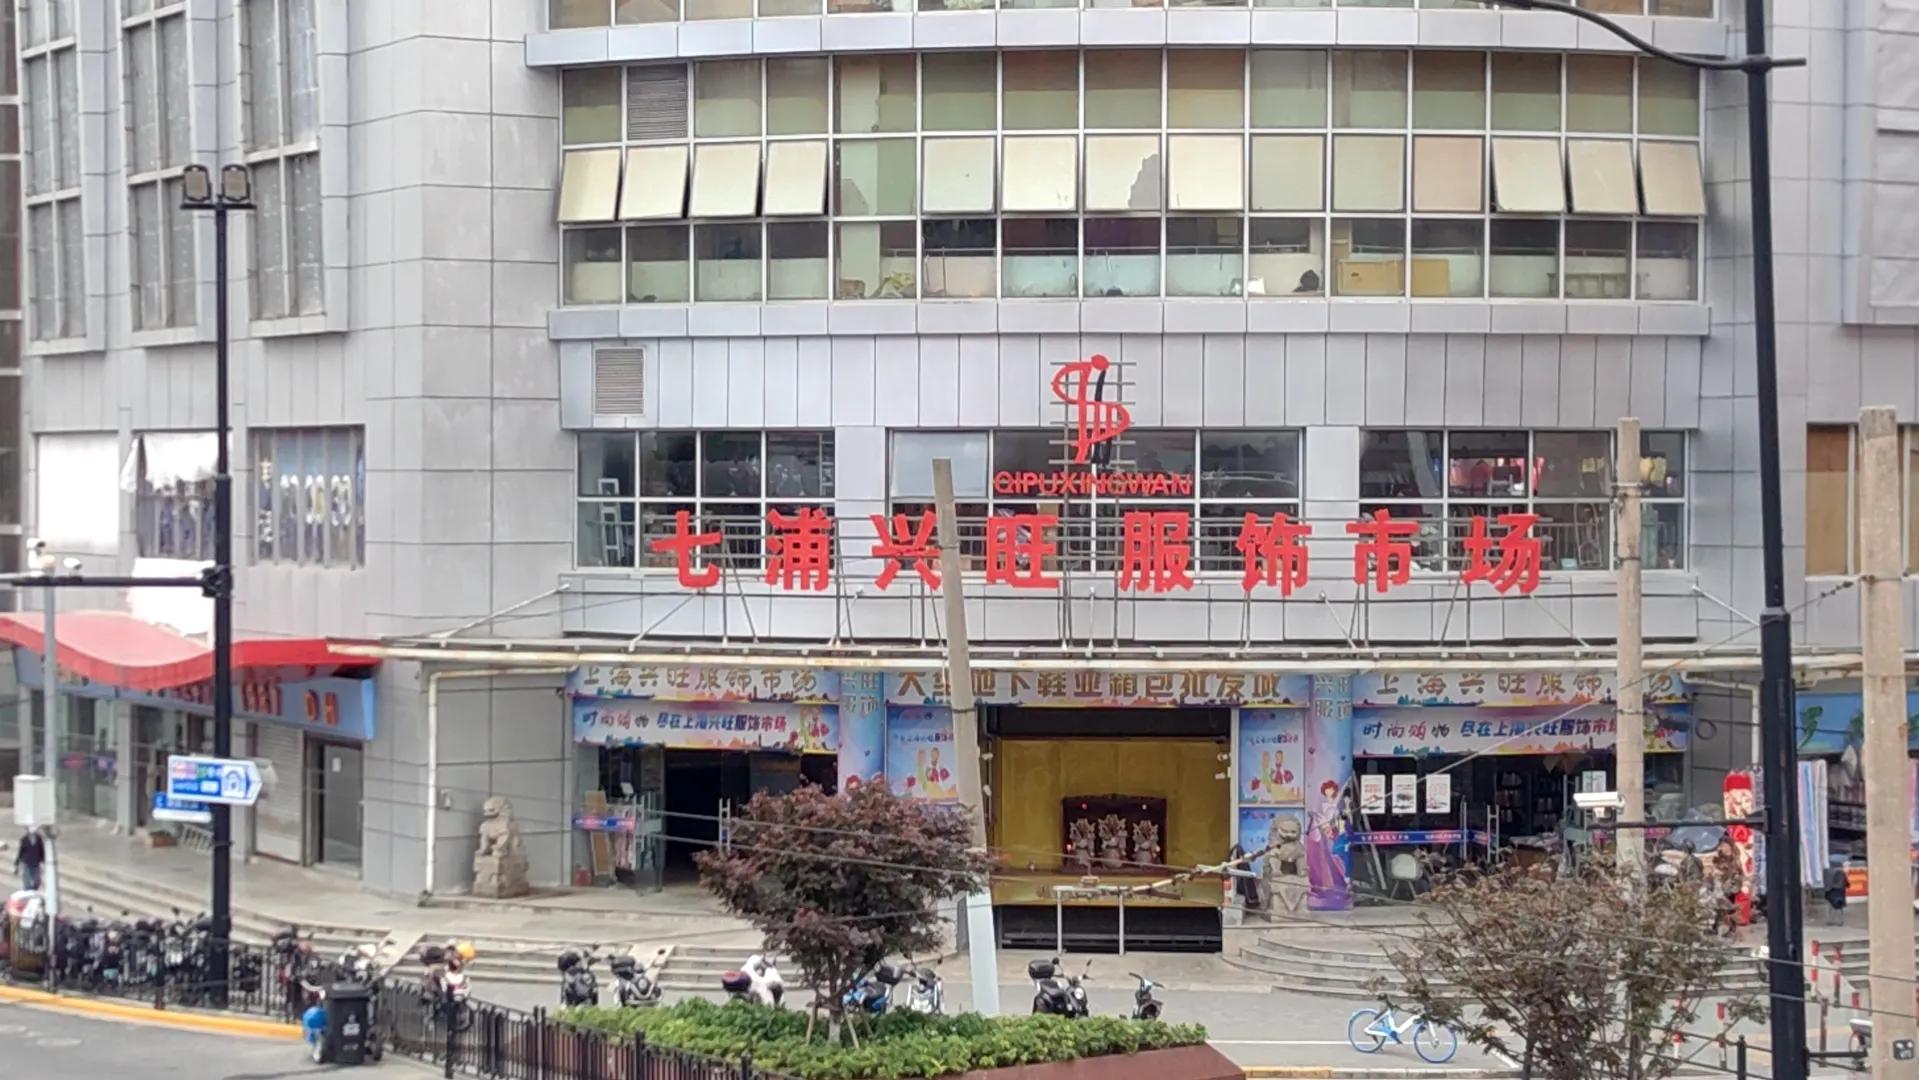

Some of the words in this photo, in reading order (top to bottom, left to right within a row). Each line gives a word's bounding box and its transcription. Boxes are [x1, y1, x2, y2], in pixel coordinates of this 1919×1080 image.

[994, 471, 1193, 496] QIPUXINGWAN
[651, 507, 1541, 596] 七浦兴旺服饰市场
[584, 666, 817, 692] 上海兴旺服饰市场
[1377, 671, 1673, 696] 上海兴旺服饰场
[1362, 720, 1450, 740] 时尚购物
